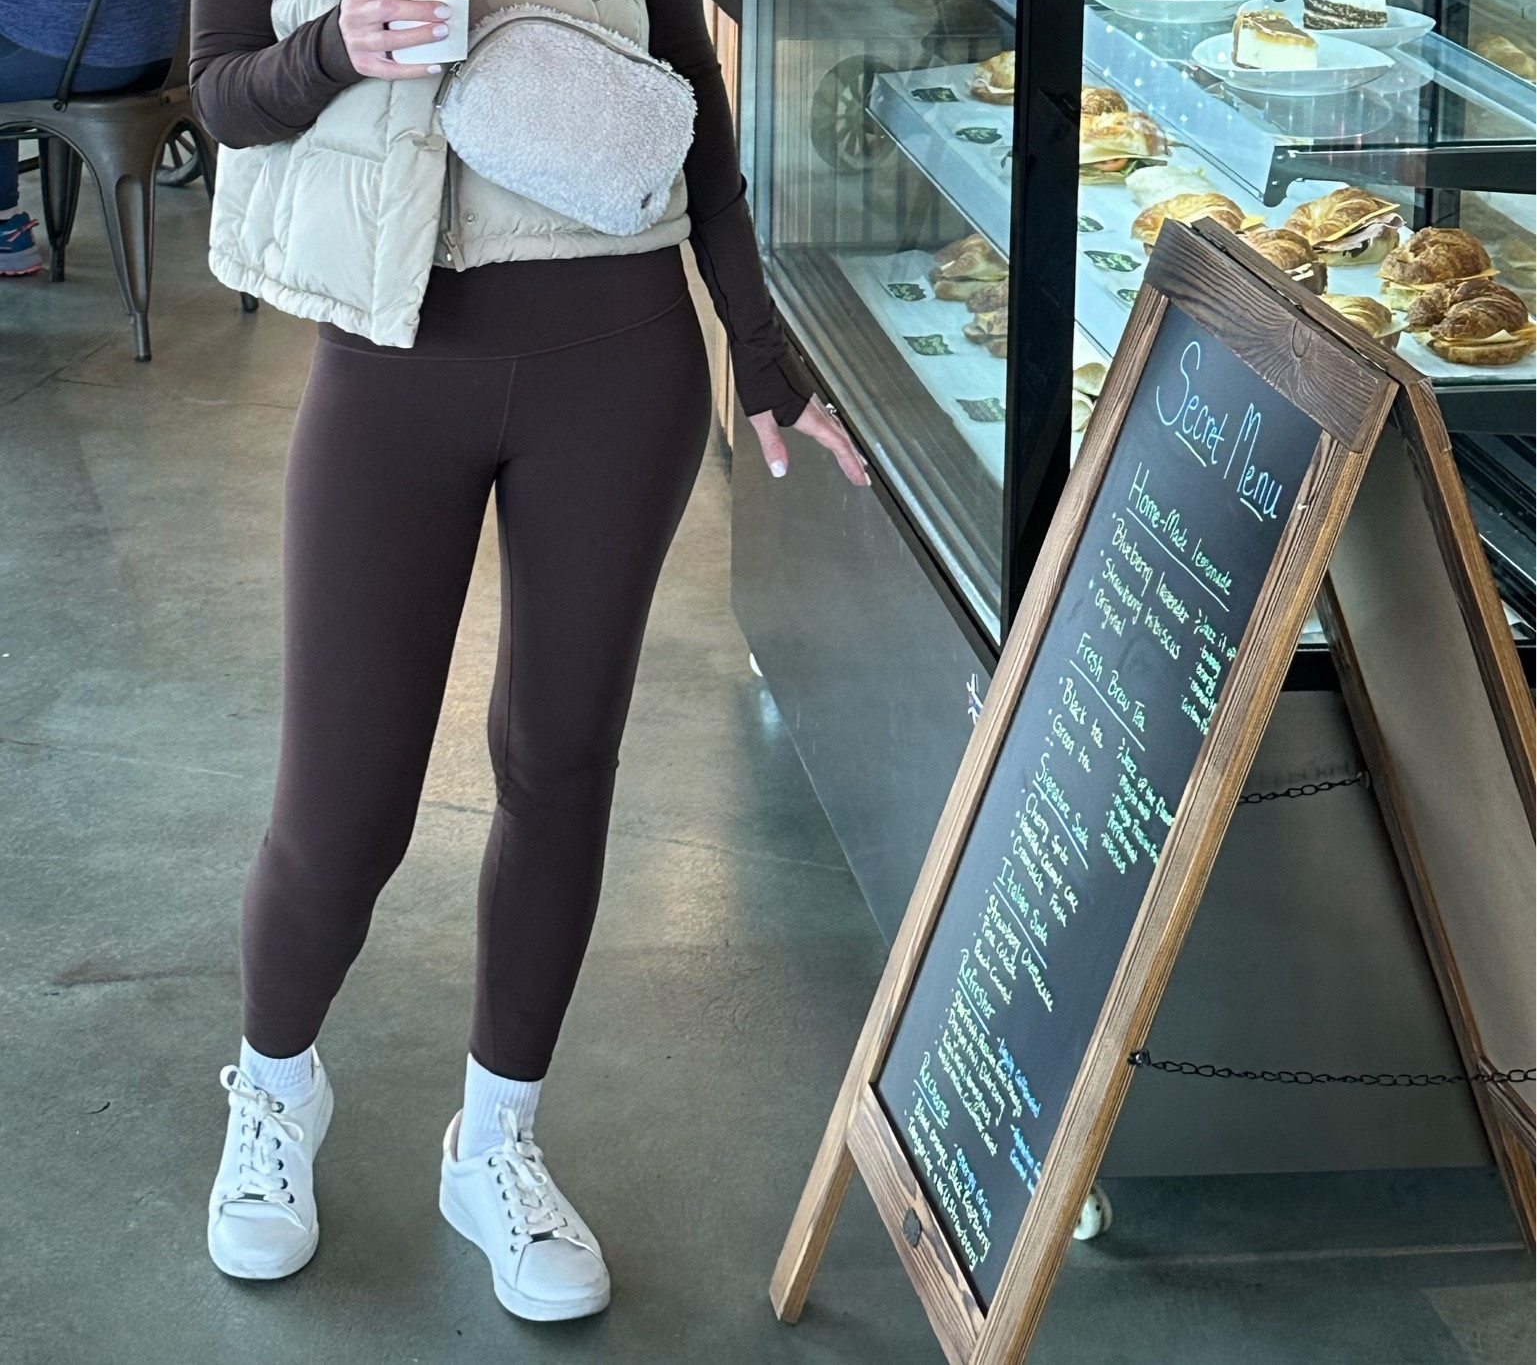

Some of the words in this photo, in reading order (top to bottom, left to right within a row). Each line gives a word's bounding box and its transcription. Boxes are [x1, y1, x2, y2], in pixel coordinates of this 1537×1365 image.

[1156, 341, 1228, 464] Secret
[1224, 404, 1282, 518] Menu
[1129, 463, 1187, 552] Home-Made
[1102, 558, 1144, 625] Strawberry
[1108, 518, 1153, 596] Blueberry
[1095, 588, 1126, 636] Original
[1063, 678, 1087, 725] Black
[1090, 718, 1103, 749] tea
[1076, 632, 1103, 682] Fresh
[1107, 669, 1130, 712] Brew
[1132, 700, 1145, 732] Tea
[1052, 714, 1075, 755] Green
[1025, 793, 1049, 843] Cherry
[1071, 812, 1089, 851] Soda
[997, 857, 1029, 917] Italian
[1030, 909, 1048, 947] Soda
